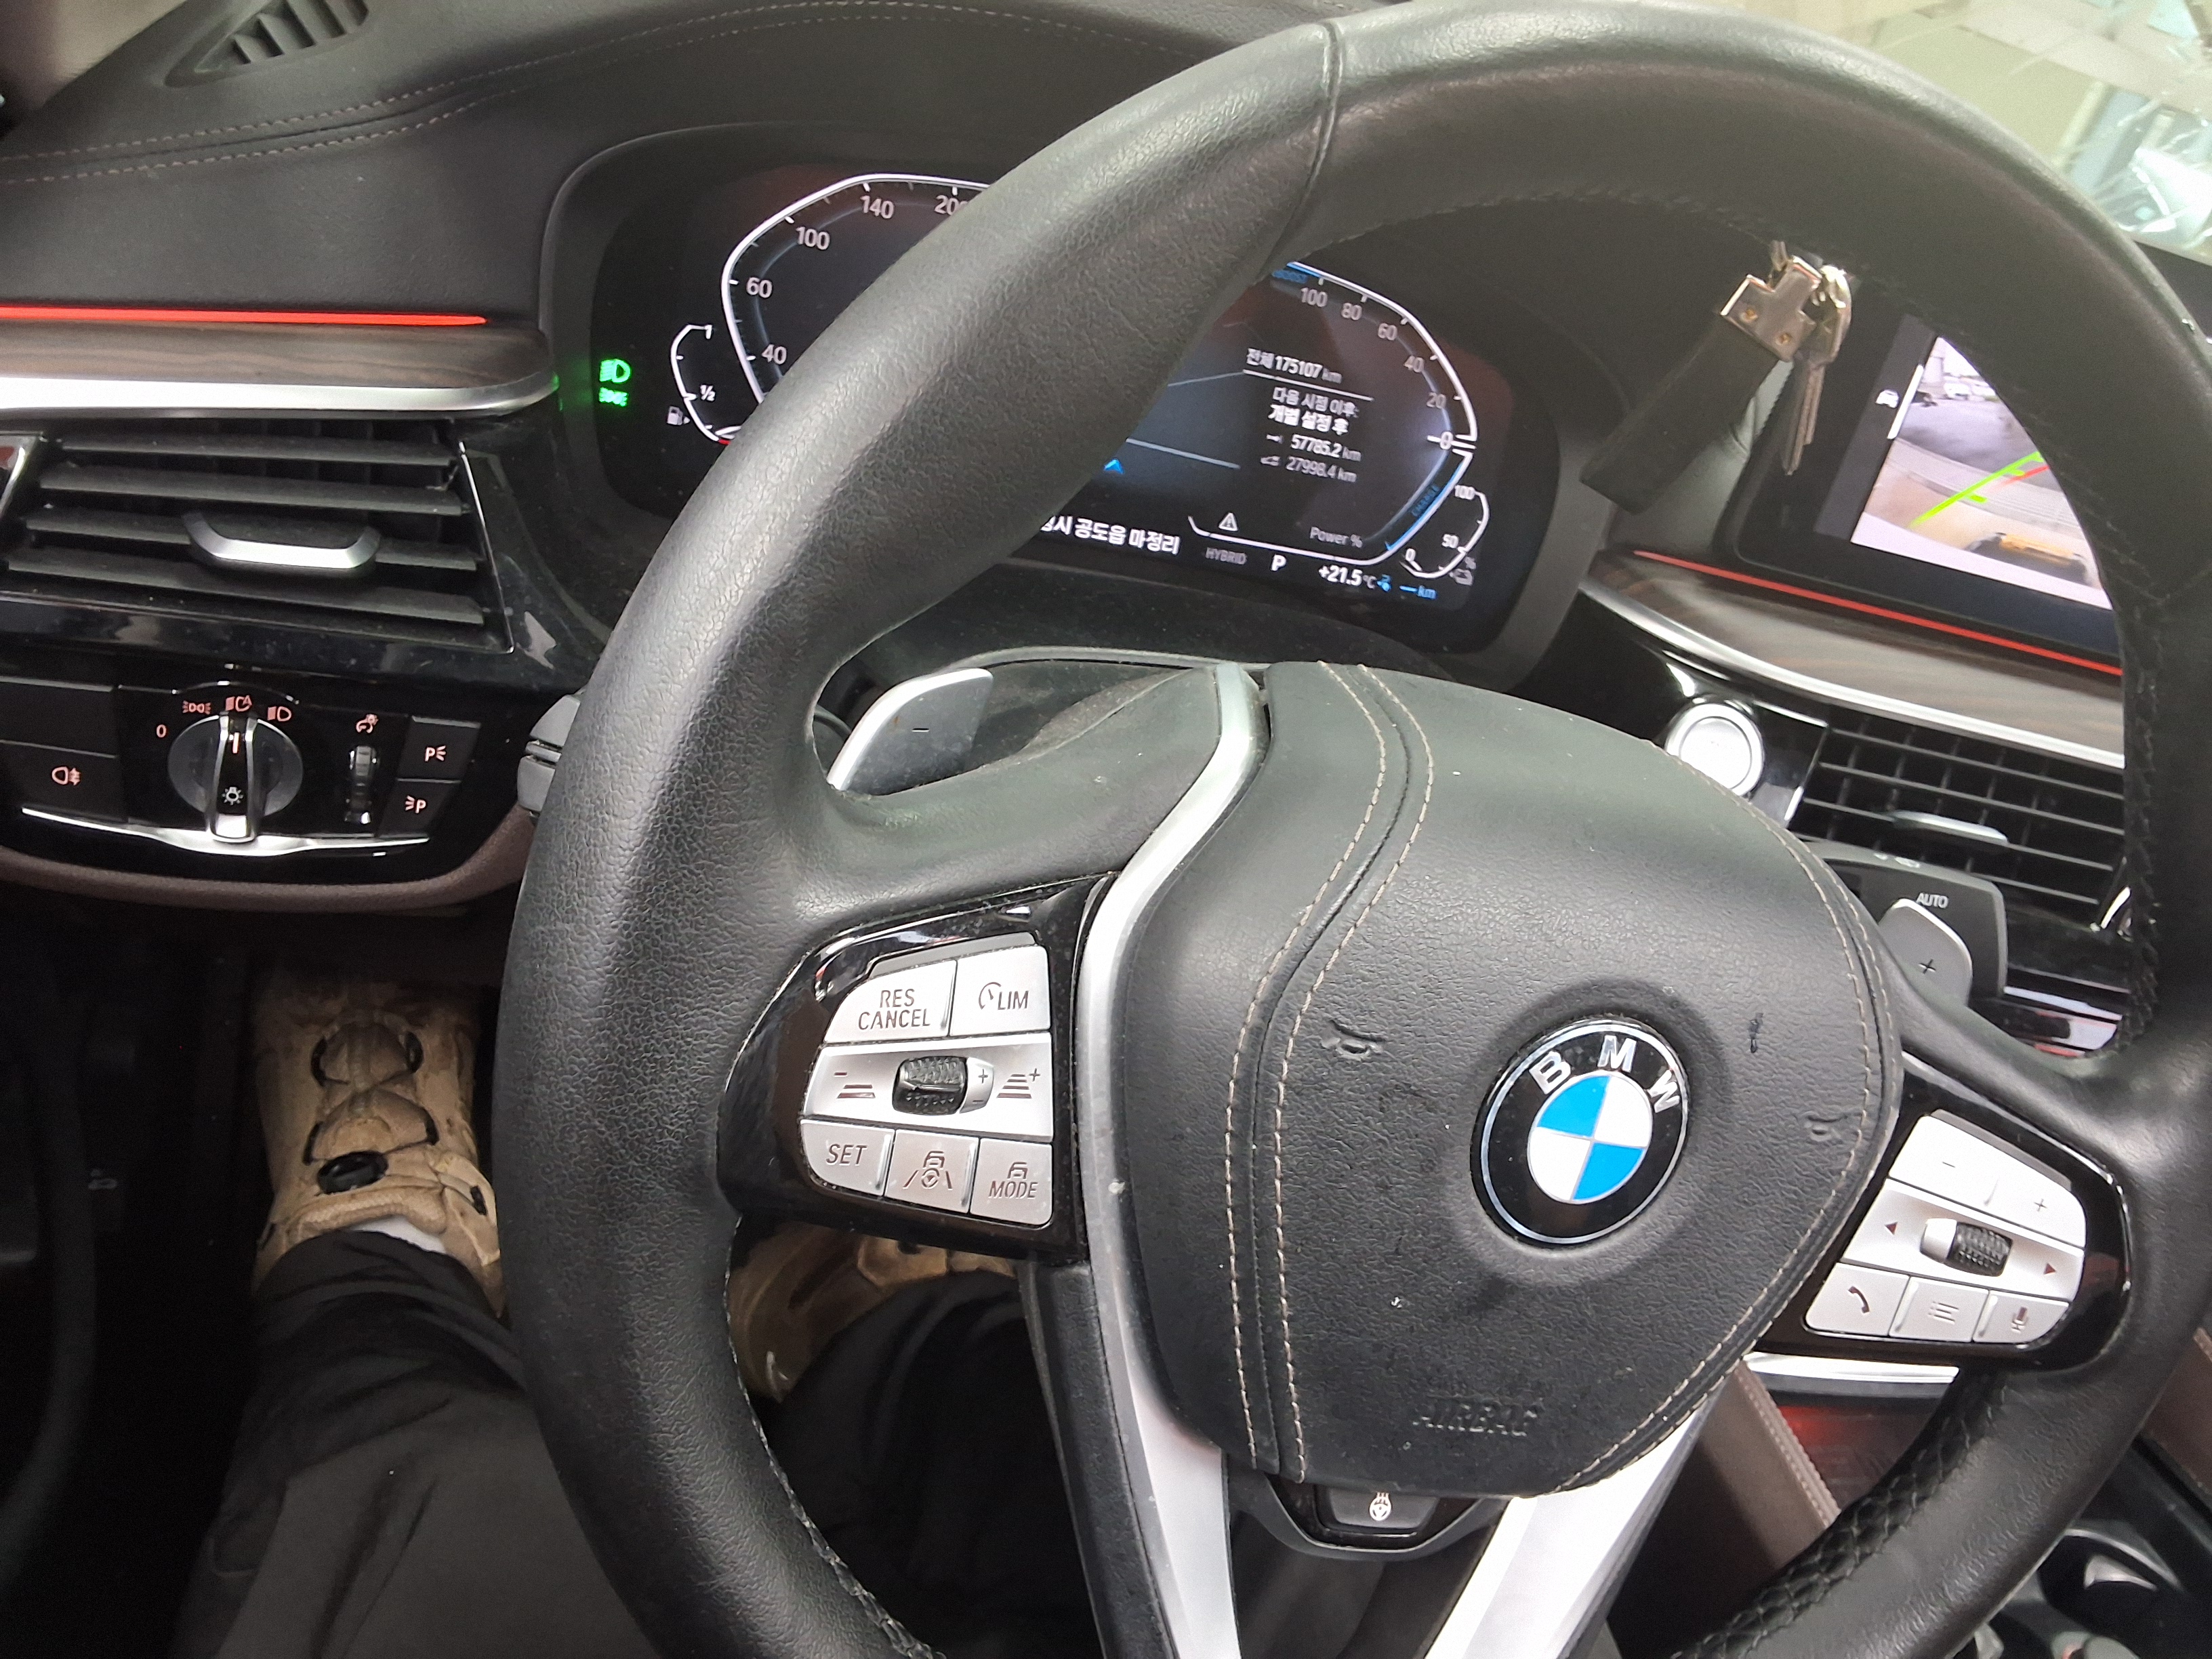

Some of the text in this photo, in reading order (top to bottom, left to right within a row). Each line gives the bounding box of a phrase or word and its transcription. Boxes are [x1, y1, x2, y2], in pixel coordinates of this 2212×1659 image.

[861, 194, 894, 219] 140
[795, 226, 831, 251] 100
[746, 276, 773, 299] 60
[1300, 287, 1328, 307] 100
[1341, 302, 1363, 321] 80
[1378, 323, 1397, 341] 60
[762, 344, 788, 365] 40
[1404, 355, 1425, 373] 40
[1275, 355, 1323, 378] 175107
[1322, 367, 1343, 384] km
[1272, 386, 1300, 406] 다음
[1426, 392, 1446, 409] 20
[1301, 410, 1332, 432] 설정
[1332, 417, 1349, 436] 후
[1342, 446, 1361, 462] km
[1337, 467, 1357, 483] km
[1454, 485, 1475, 500] 100
[1075, 517, 1126, 546] 공도읍
[1128, 528, 1181, 555] 마정리
[1309, 526, 1350, 546] Power
[1441, 533, 1459, 548] 50
[1205, 547, 1248, 565] HYBRID
[1271, 554, 1287, 571] P
[1405, 548, 1416, 562] 0
[1318, 565, 1363, 587] +21.5
[1917, 893, 1948, 909] AUTO
[880, 988, 915, 1008] RES
[997, 990, 1029, 1010] LIM
[858, 1009, 930, 1030] CANCEL
[1529, 1036, 1680, 1113] BMW
[825, 1145, 867, 1166] SET
[989, 1181, 1038, 1200] MODE
